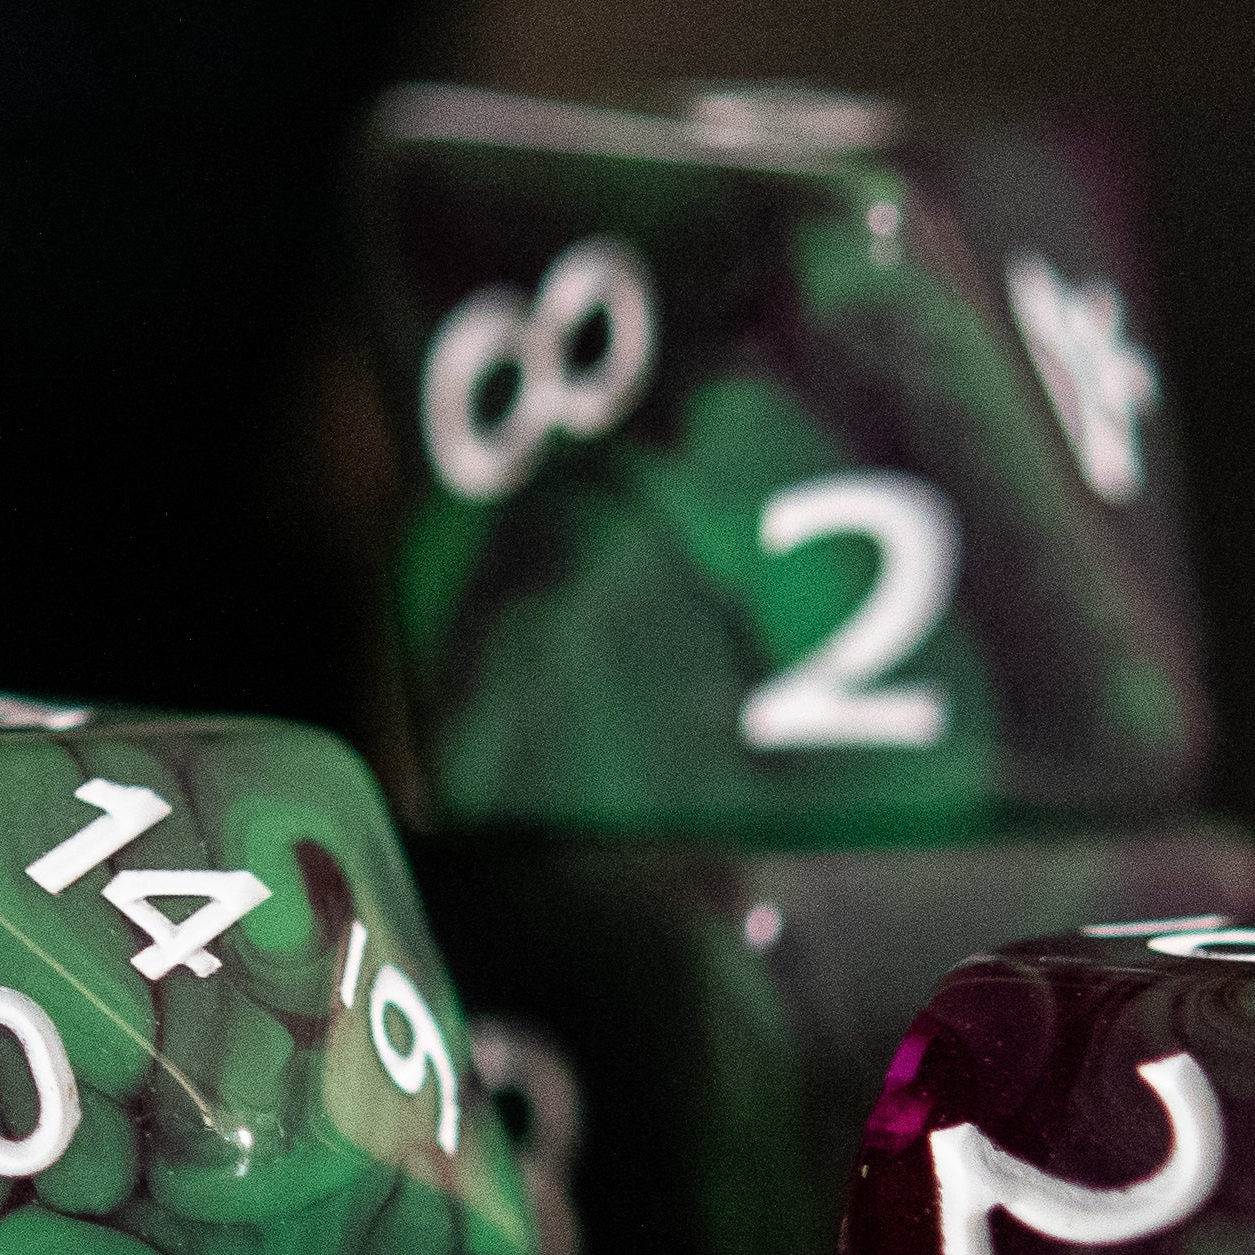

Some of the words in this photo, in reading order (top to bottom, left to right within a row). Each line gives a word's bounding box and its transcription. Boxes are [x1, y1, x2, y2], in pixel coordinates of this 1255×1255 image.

[421, 240, 657, 502] 8
[741, 472, 961, 748] 2
[26, 777, 272, 982] 14
